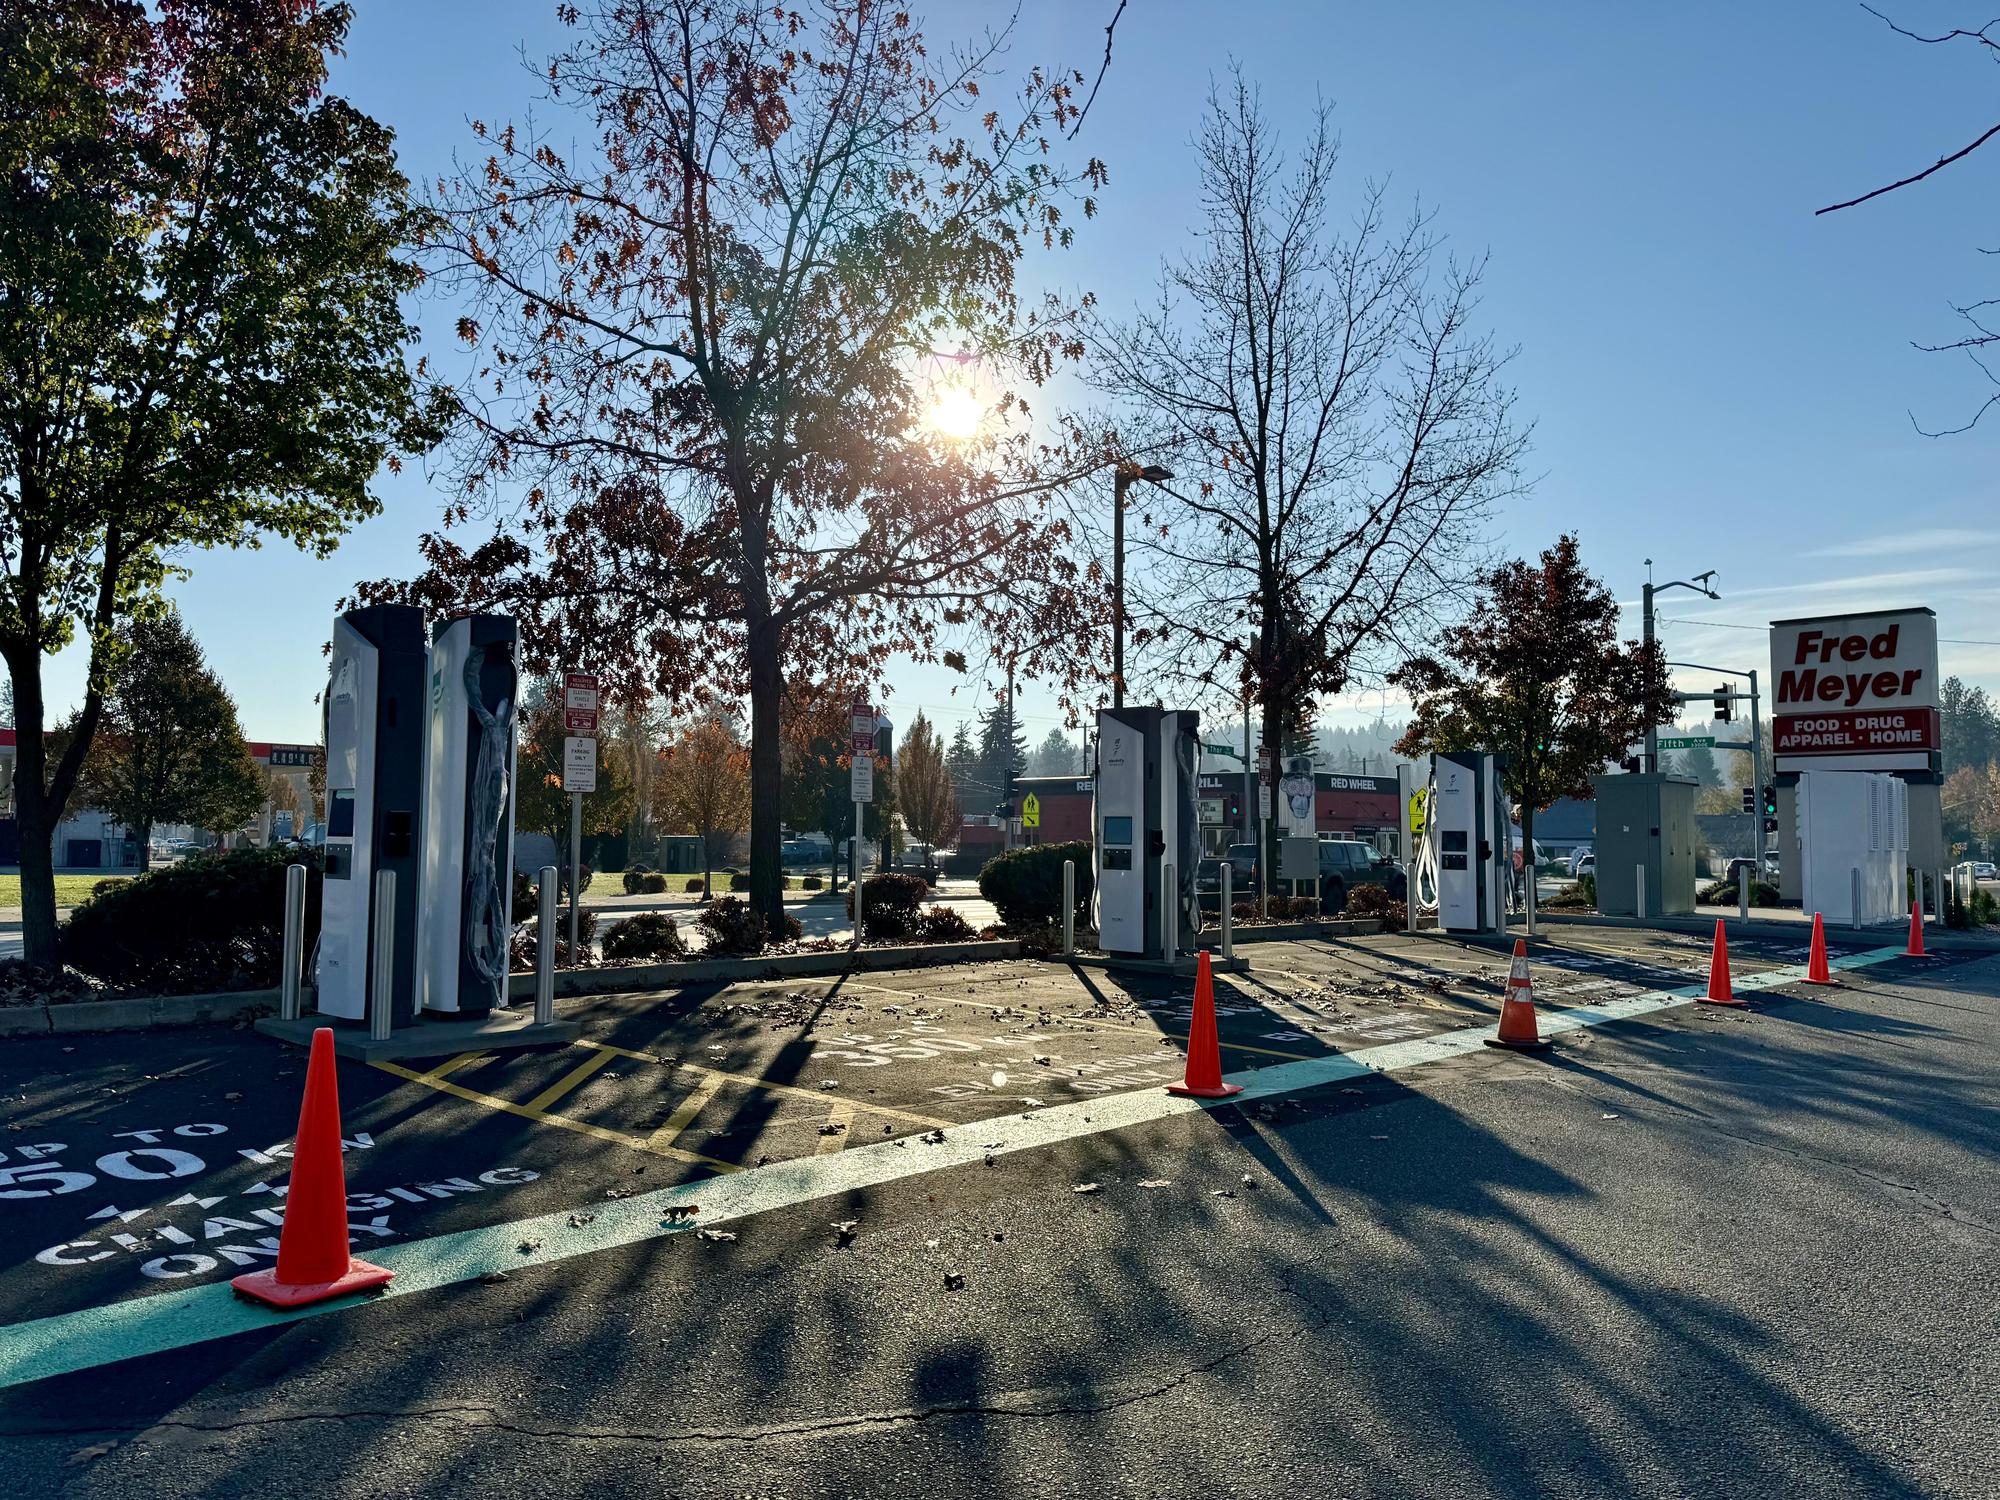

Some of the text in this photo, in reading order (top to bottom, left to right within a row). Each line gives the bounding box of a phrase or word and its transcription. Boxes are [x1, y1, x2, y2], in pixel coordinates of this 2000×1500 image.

[1794, 624, 1900, 665] Fred
[1777, 668, 1922, 707] Meyer
[1793, 716, 1905, 733] FOOD DRUG
[1656, 739, 1685, 748] Fifth
[1779, 730, 1922, 747] APPAREL HOME
[1076, 781, 1095, 792] RE
[1331, 777, 1377, 791] RED WHEEL
[810, 1037, 984, 1067] 350
[1069, 1069, 1174, 1091] ONLY
[112, 1123, 229, 1143] TO
[139, 1214, 398, 1279] ONY
